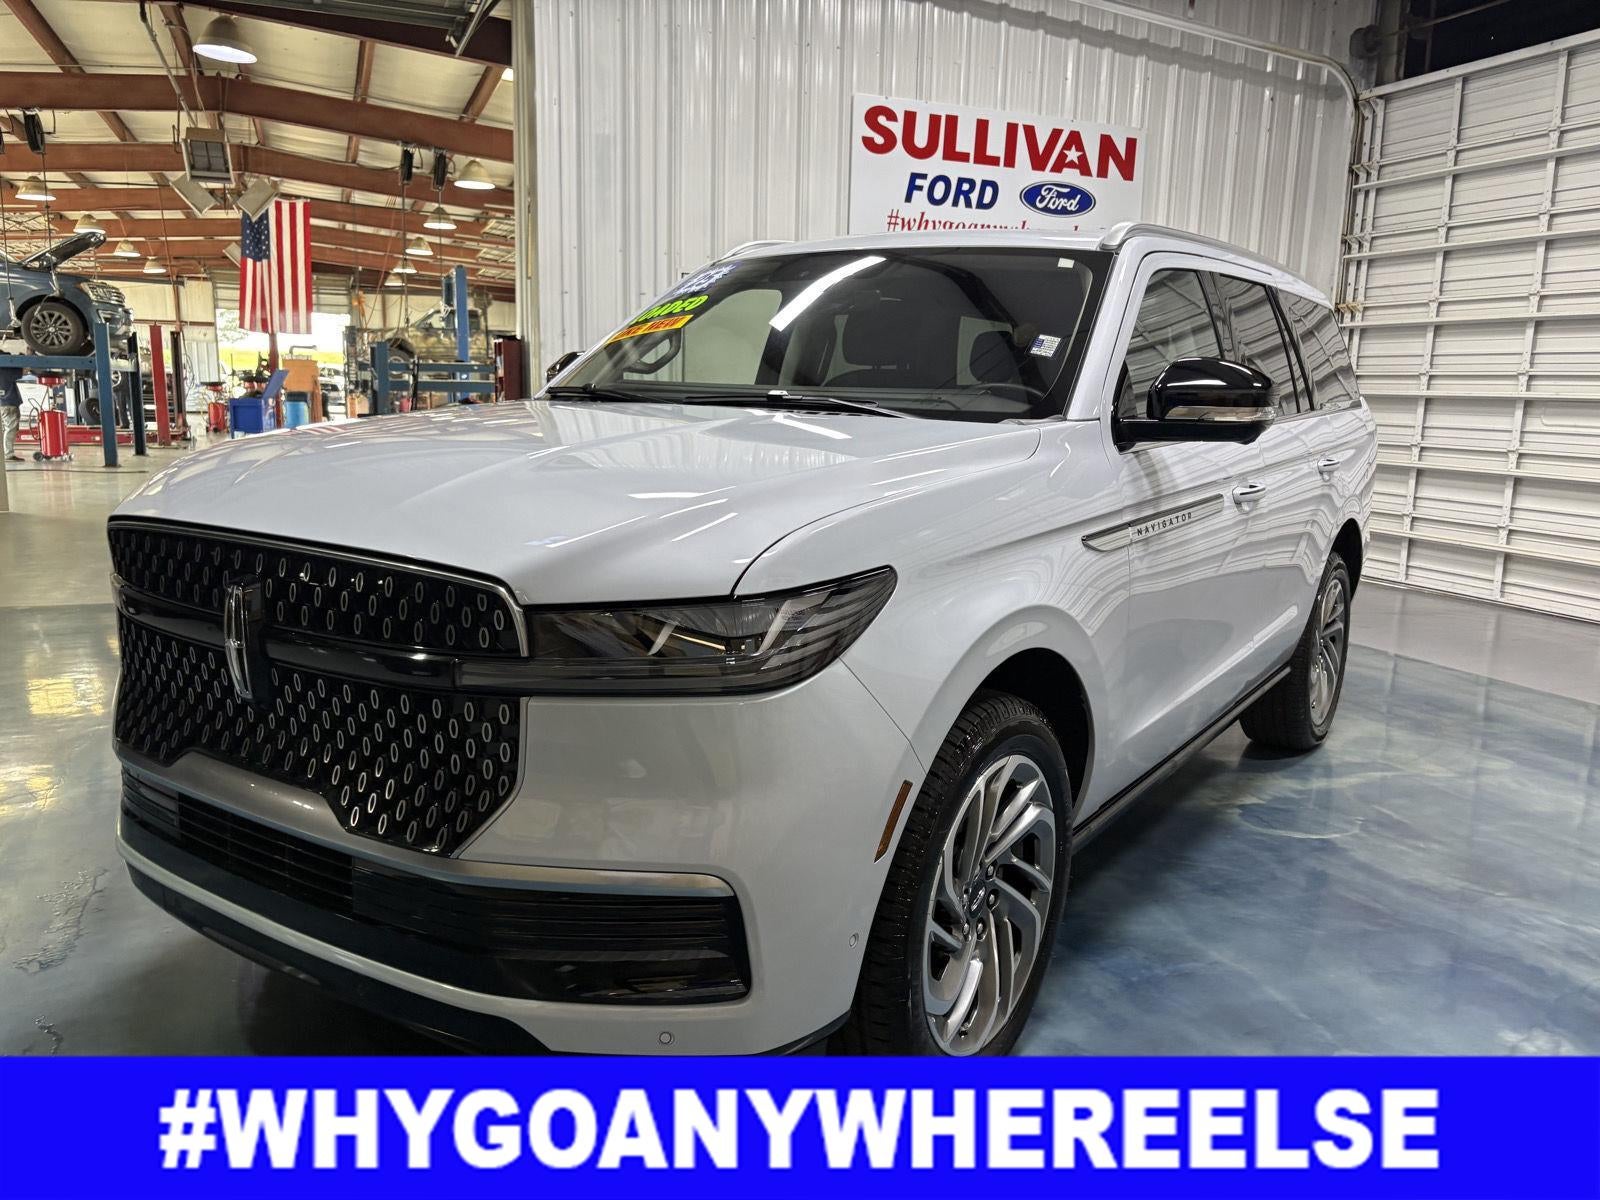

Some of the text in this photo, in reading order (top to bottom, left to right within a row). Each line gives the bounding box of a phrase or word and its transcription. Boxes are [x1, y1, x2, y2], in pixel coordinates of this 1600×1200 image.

[861, 105, 1138, 182] SULLIVAN
[904, 172, 1000, 211] FORD
[1035, 184, 1081, 211] Ford
[1136, 511, 1193, 536] NAVIGATOR
